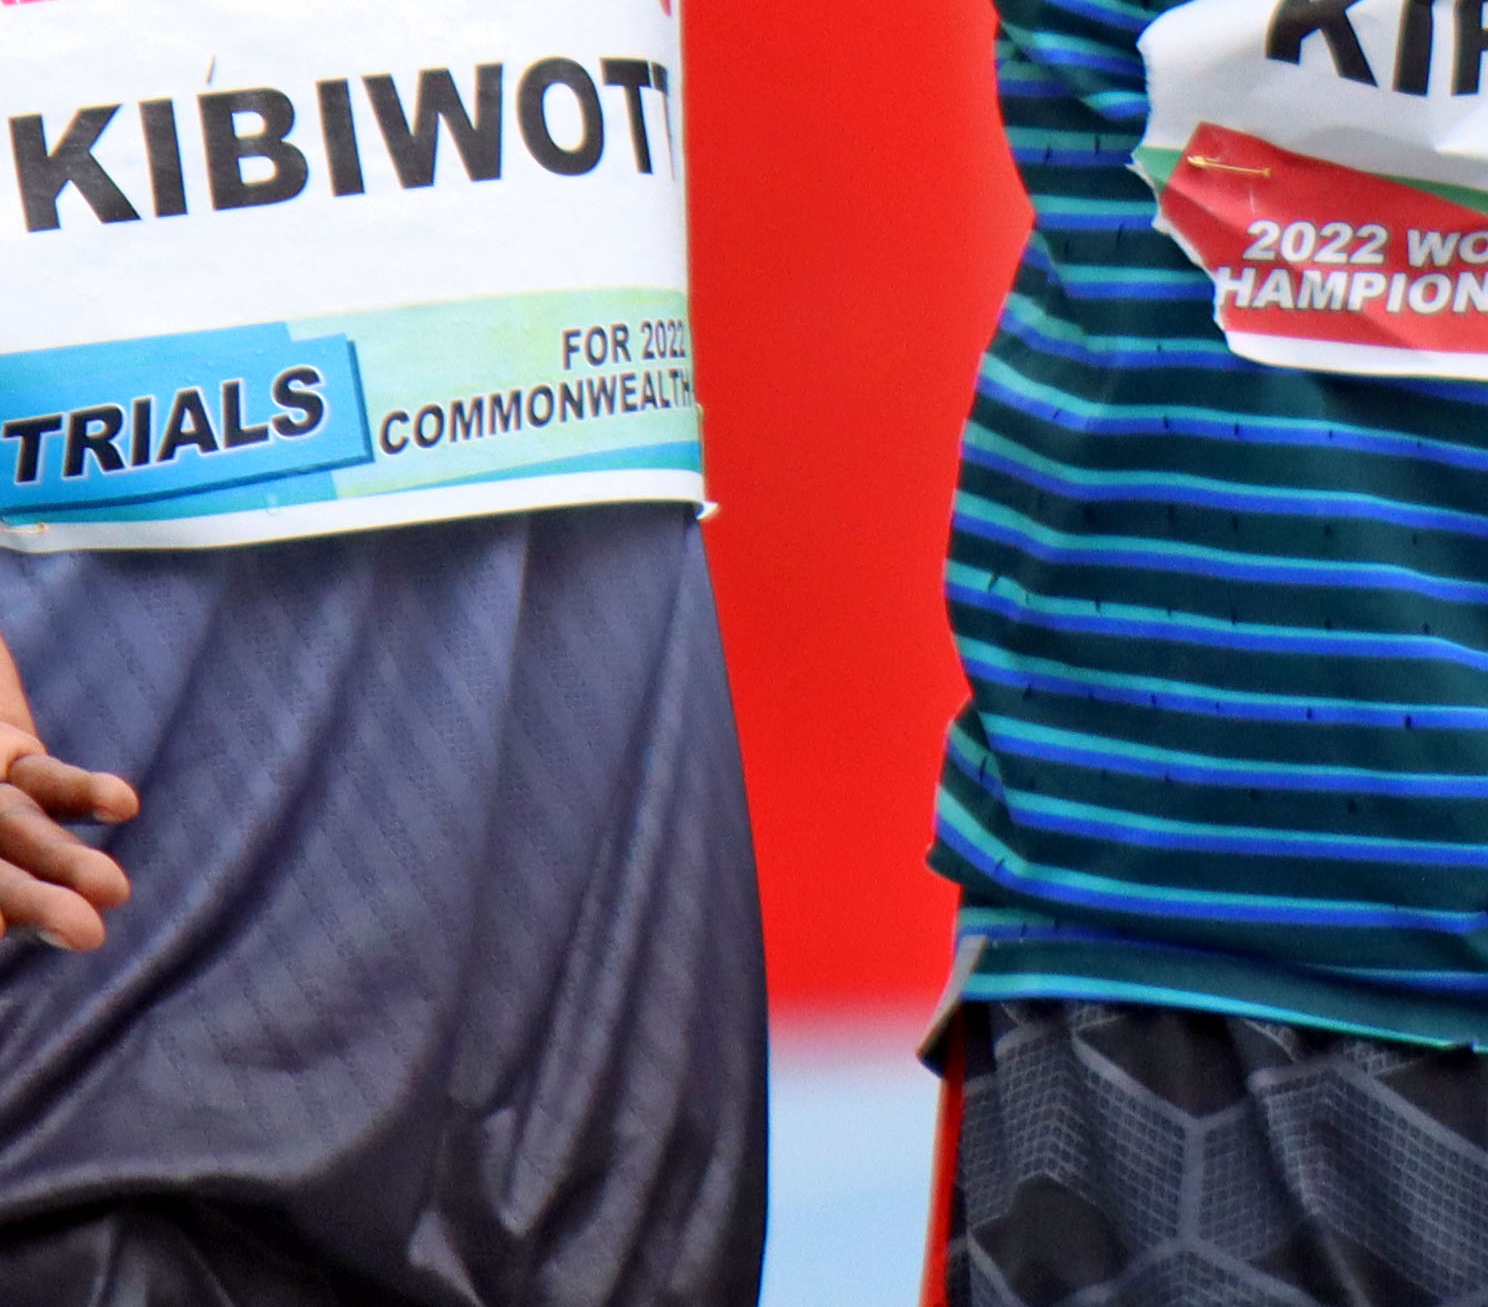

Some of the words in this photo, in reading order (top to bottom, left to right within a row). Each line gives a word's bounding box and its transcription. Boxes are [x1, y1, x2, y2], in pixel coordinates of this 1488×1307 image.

[1242, 219, 1390, 266] 2022
[562, 323, 631, 370] FOR
[640, 319, 687, 360] 2022
[2, 365, 326, 483] TRIALS
